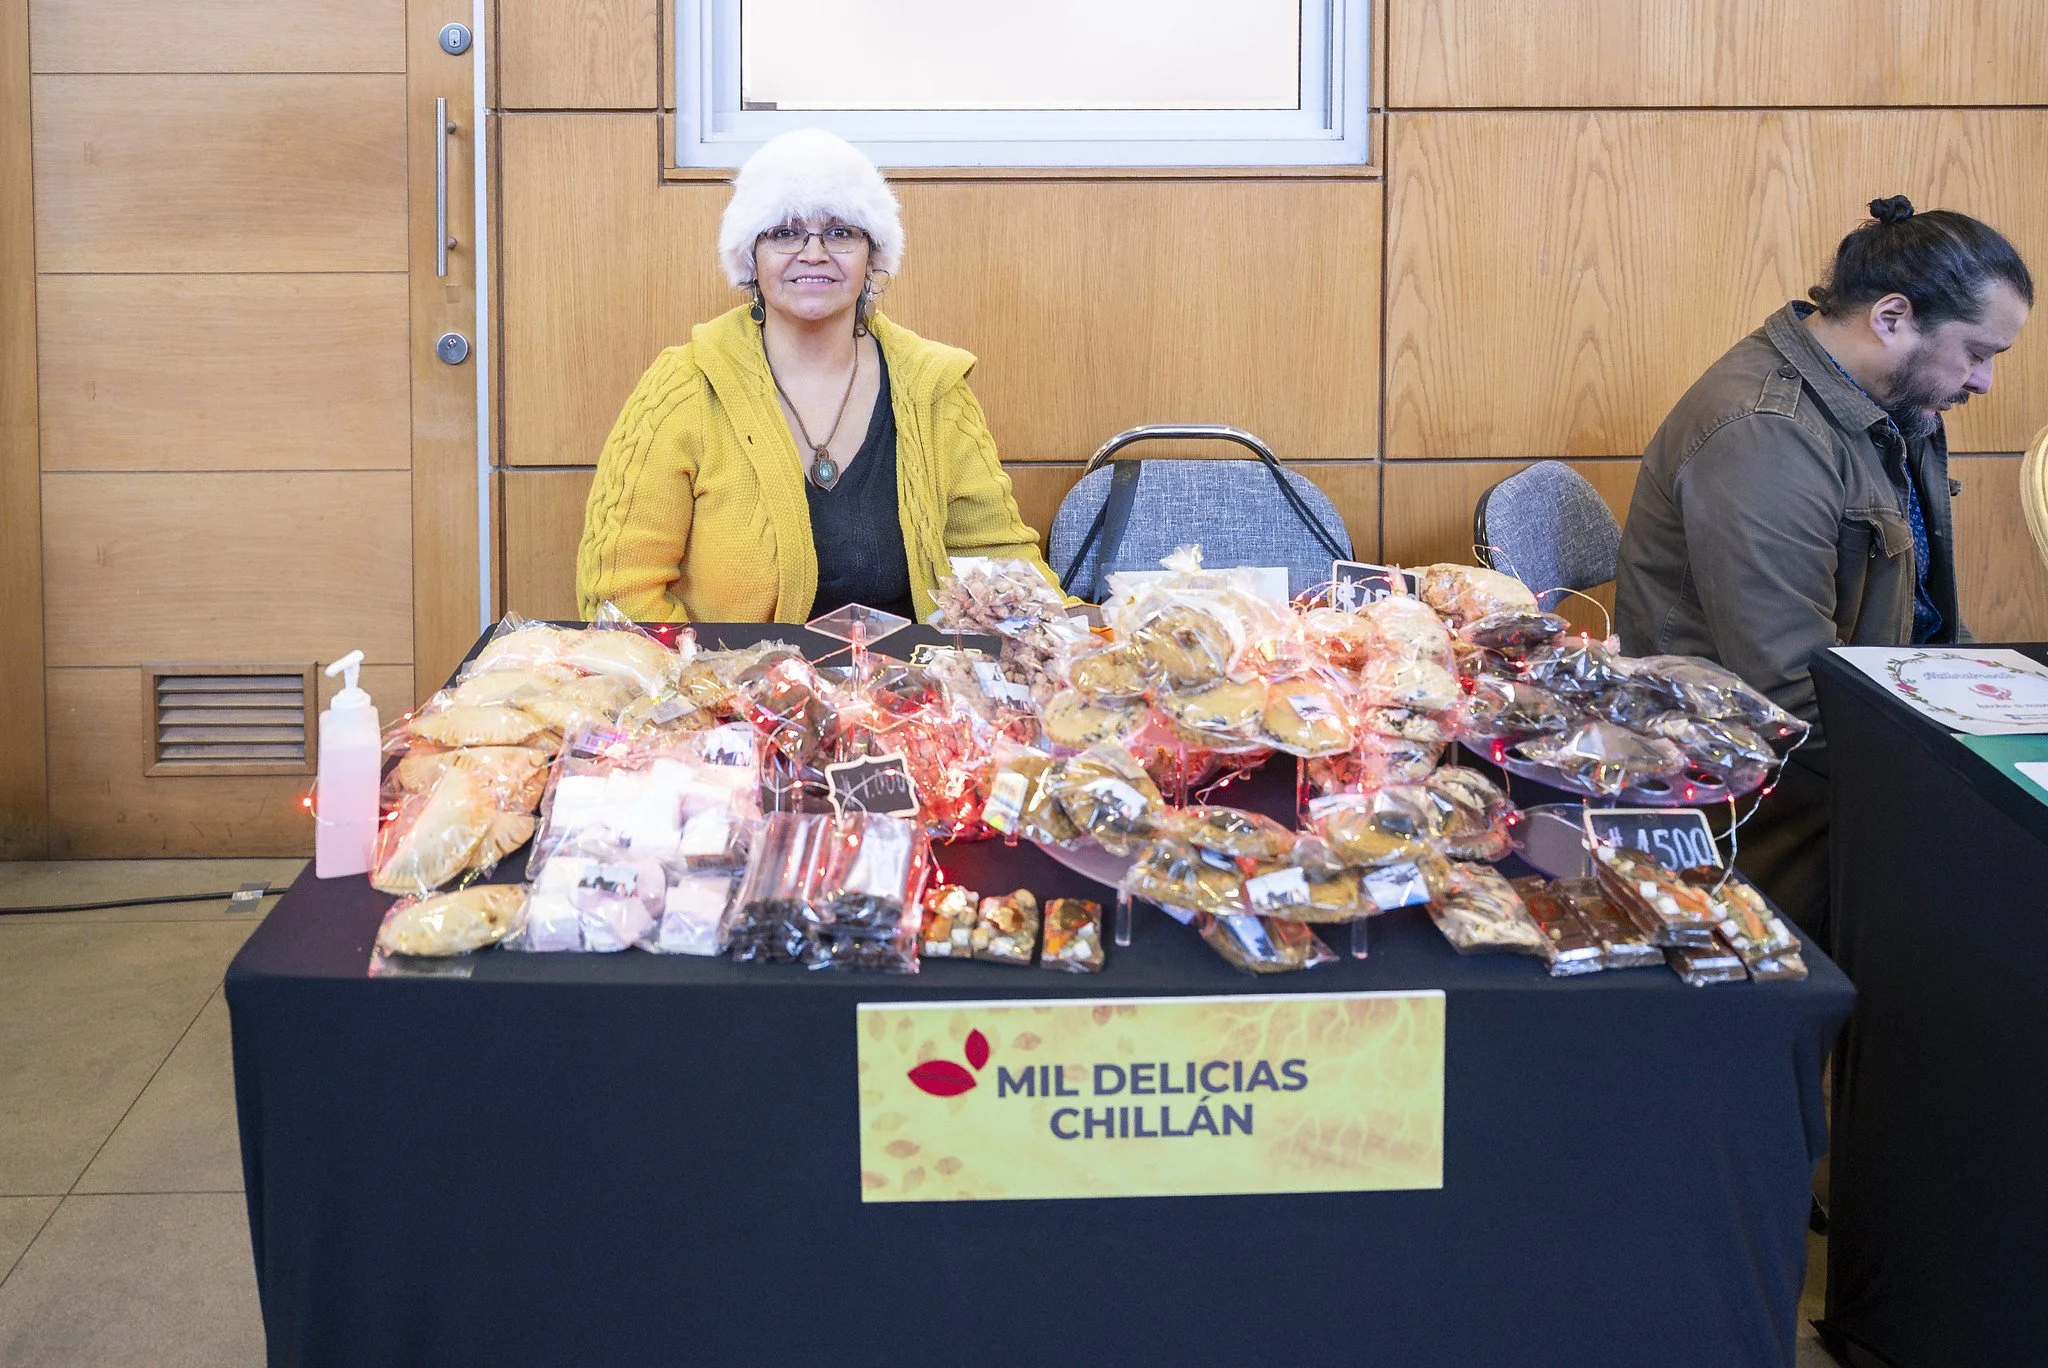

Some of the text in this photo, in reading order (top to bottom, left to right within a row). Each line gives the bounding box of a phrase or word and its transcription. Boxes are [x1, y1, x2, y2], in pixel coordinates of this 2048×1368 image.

[997, 1059, 1309, 1098] MIL DELICIAS
[1049, 1095, 1254, 1140] CHILLÁN
